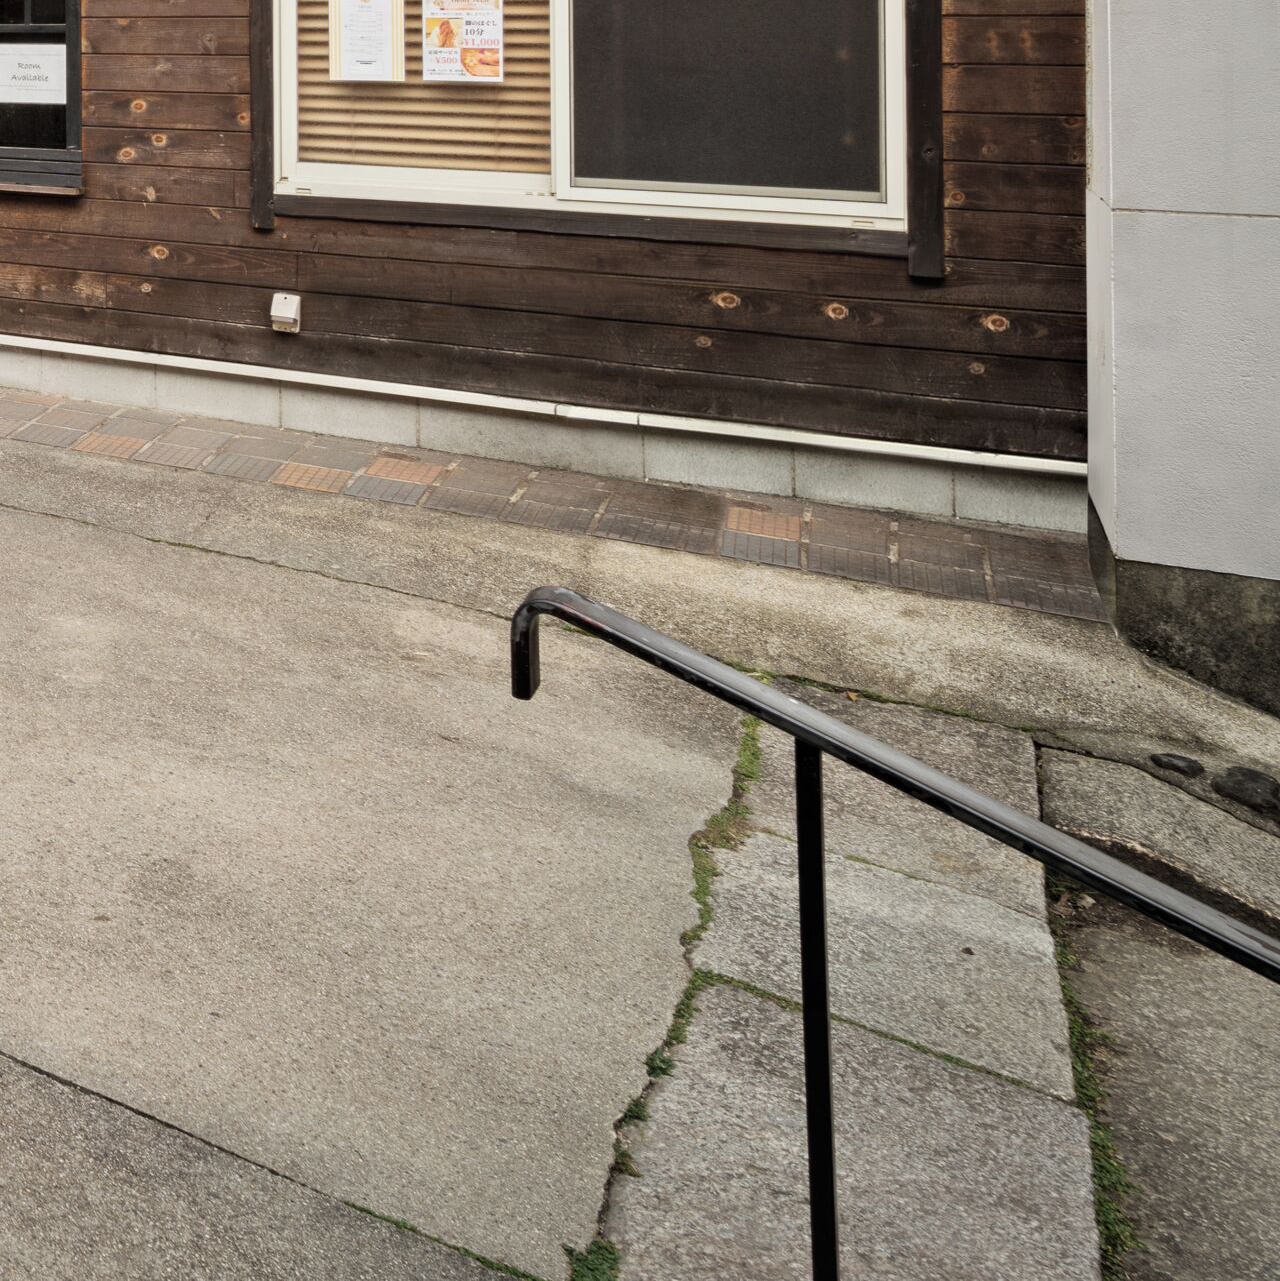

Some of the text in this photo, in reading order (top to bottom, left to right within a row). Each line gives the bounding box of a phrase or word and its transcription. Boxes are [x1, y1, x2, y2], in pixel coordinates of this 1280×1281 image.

[465, 28, 484, 36] 10分
[17, 62, 42, 70] Room
[10, 74, 49, 82] Available
